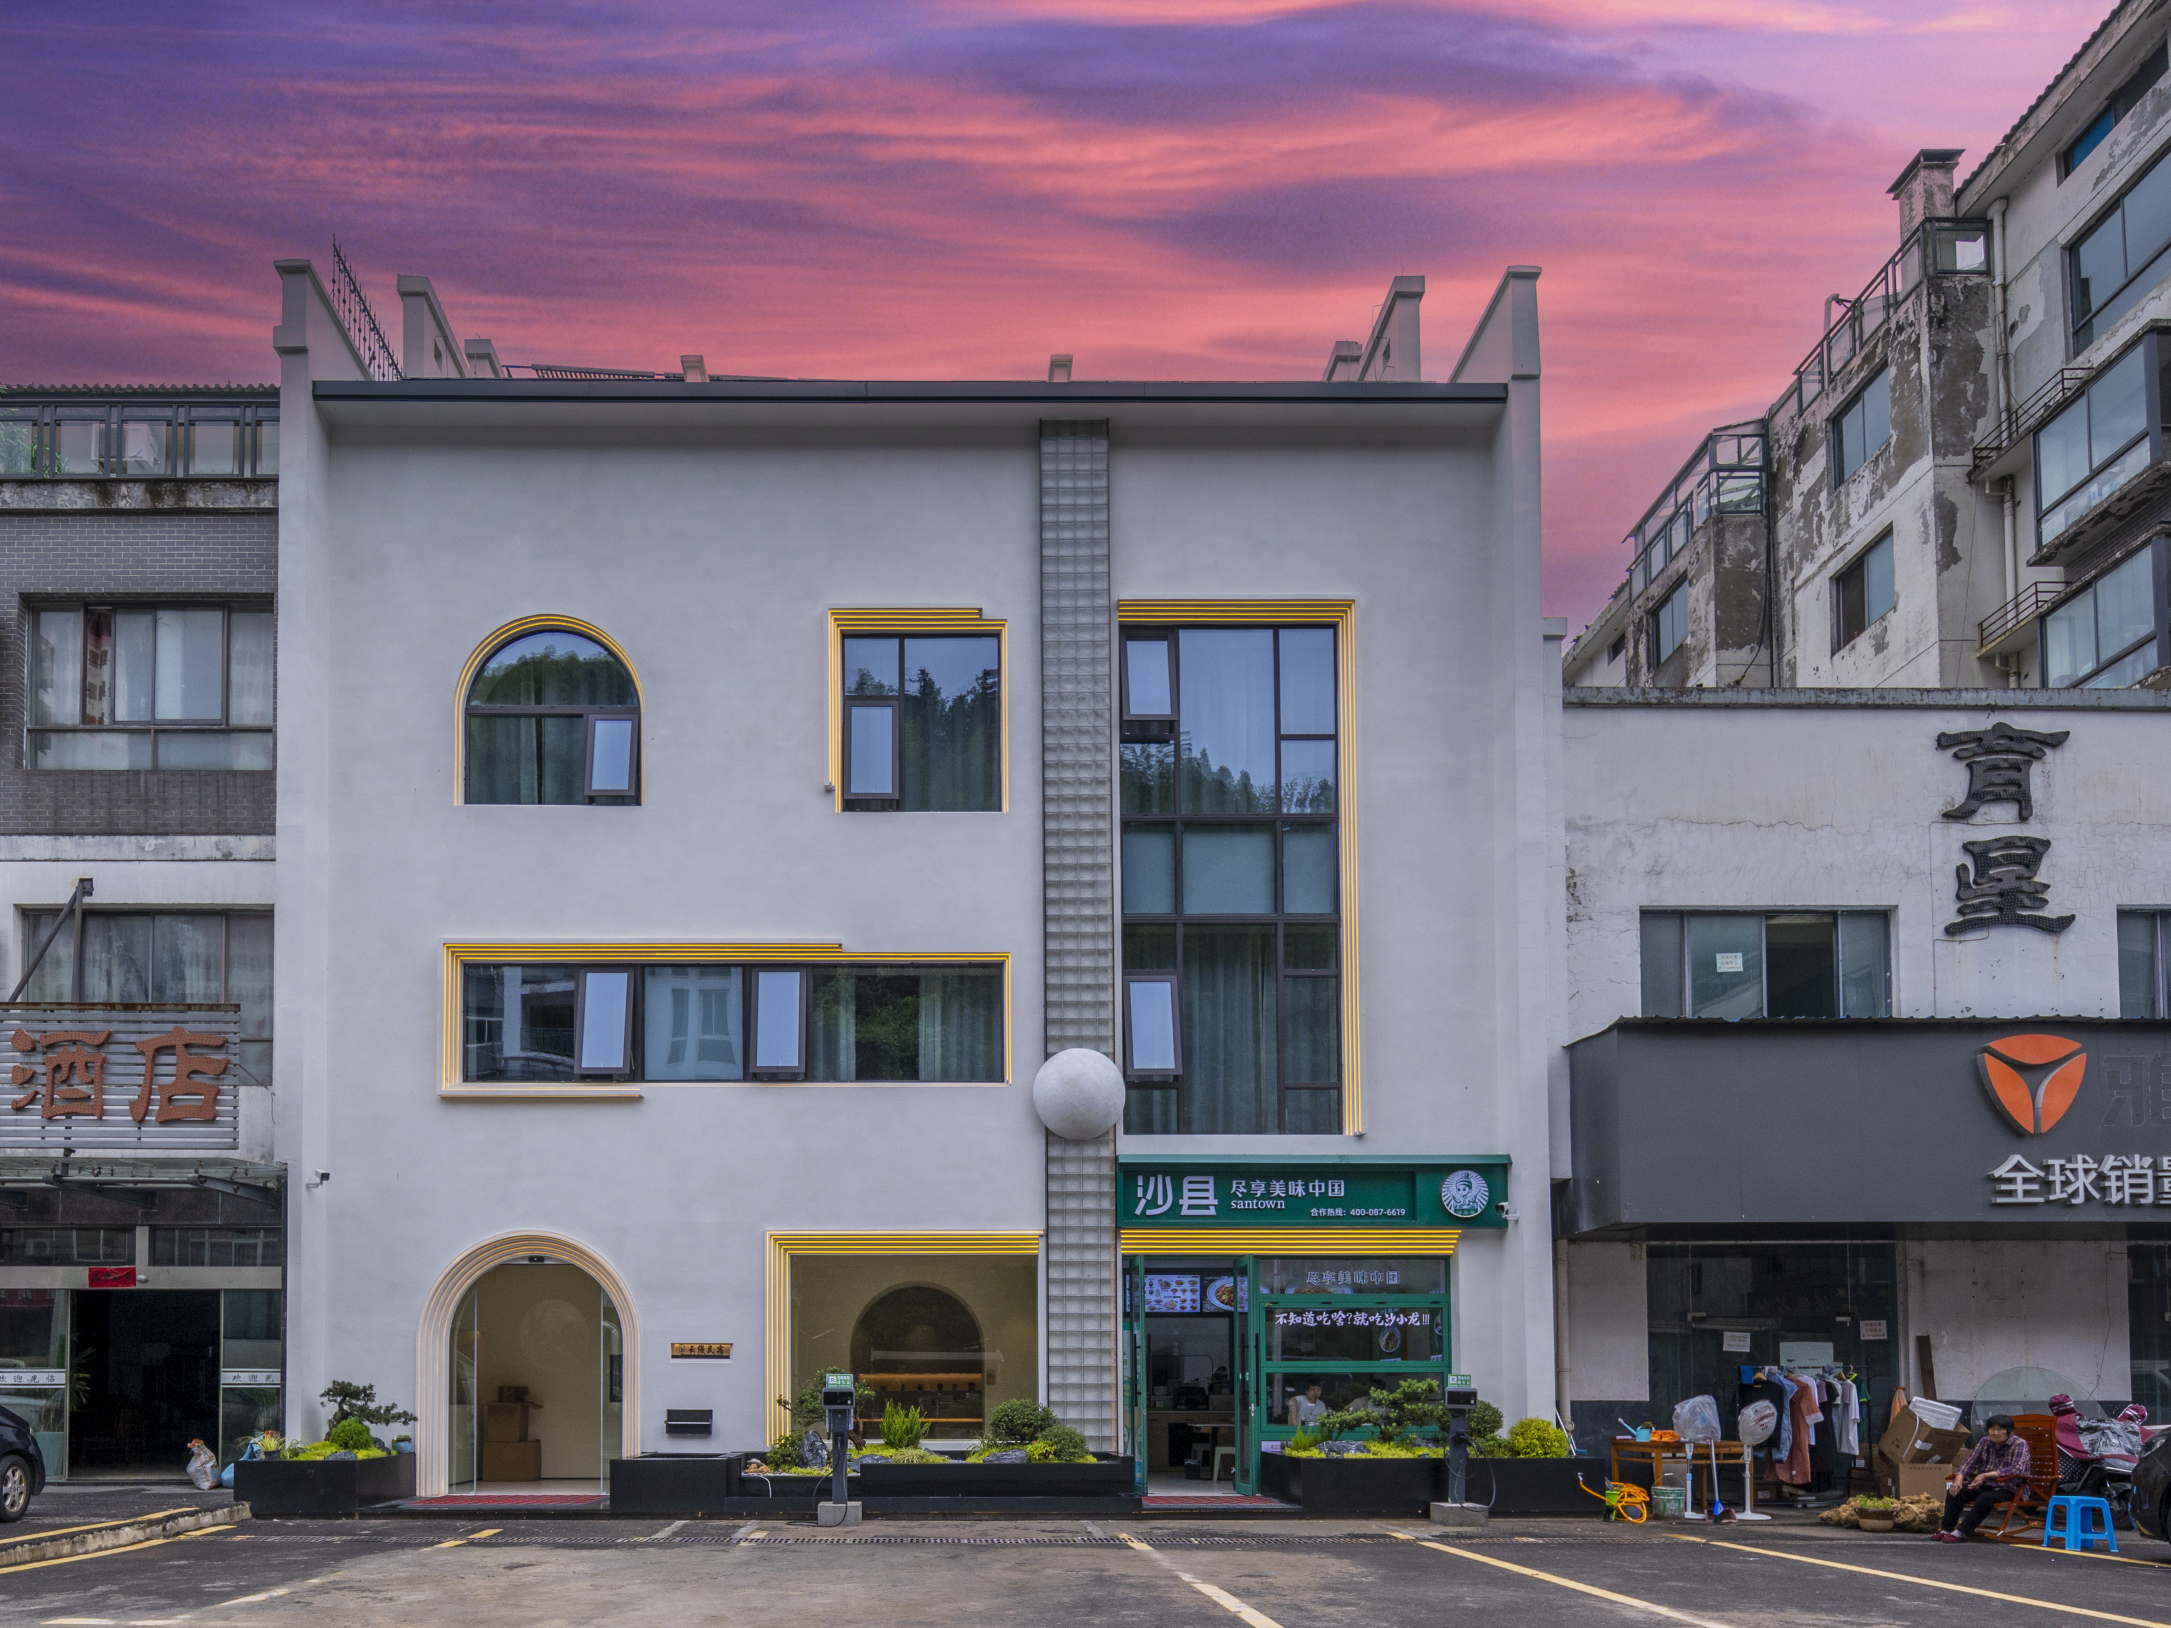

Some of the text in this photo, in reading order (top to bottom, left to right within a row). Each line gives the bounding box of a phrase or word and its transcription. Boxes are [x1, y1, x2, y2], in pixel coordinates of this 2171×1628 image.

[10, 1025, 231, 1124] 酒店
[1230, 1179, 1345, 1198] 尽享美味中国
[1988, 1154, 2171, 1205] 全球销
[1134, 1174, 1219, 1216] 沙县
[1230, 1198, 1286, 1209] santown
[1350, 1208, 1405, 1216] 400-087-6619
[1306, 1270, 1400, 1285] 尽享美味中国
